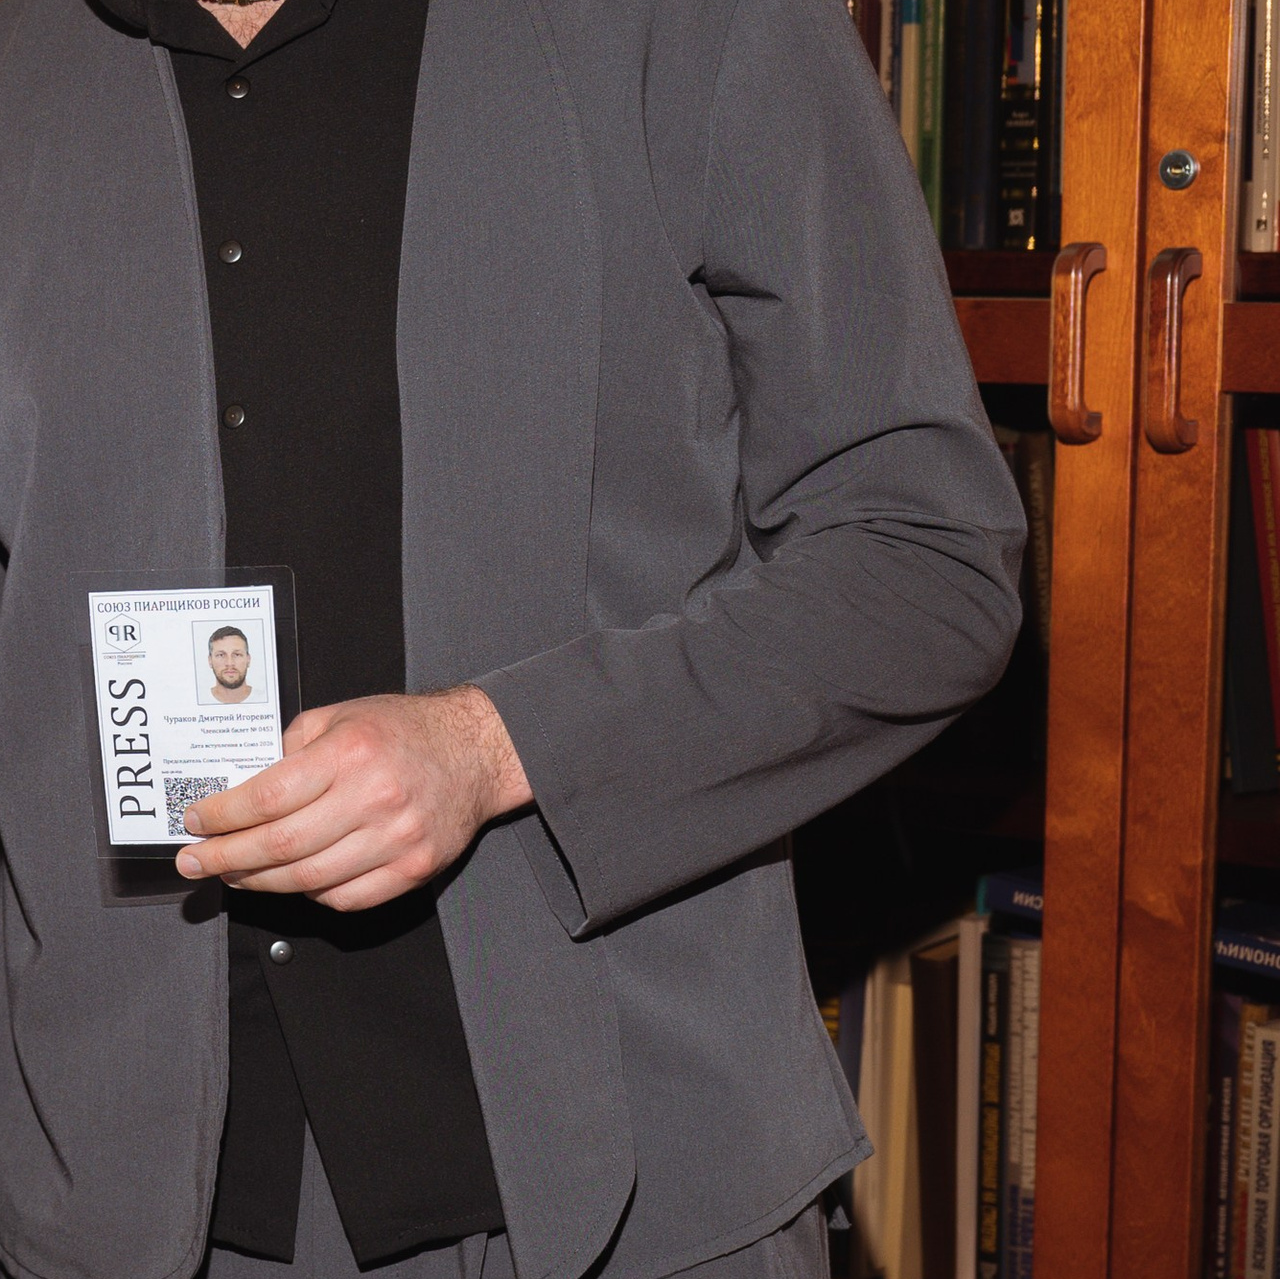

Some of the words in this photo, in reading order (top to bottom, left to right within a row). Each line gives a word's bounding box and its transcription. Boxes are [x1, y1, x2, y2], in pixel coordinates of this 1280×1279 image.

[97, 601, 131, 613] СОЮЗ
[134, 599, 210, 613] ПИАРЩИКОВ
[214, 597, 260, 610] РОССИИ
[108, 677, 157, 819] PRESS
[163, 715, 196, 725] Чураков
[198, 714, 235, 724] Дмитрий
[236, 712, 274, 723] Игоревич
[1255, 1038, 1278, 1129] ОРГАНИЗАЦИЯ
[1253, 1131, 1273, 1193] ТОРГОВАЯ
[1249, 1197, 1269, 1271] ВСЕМИРНАЯ
